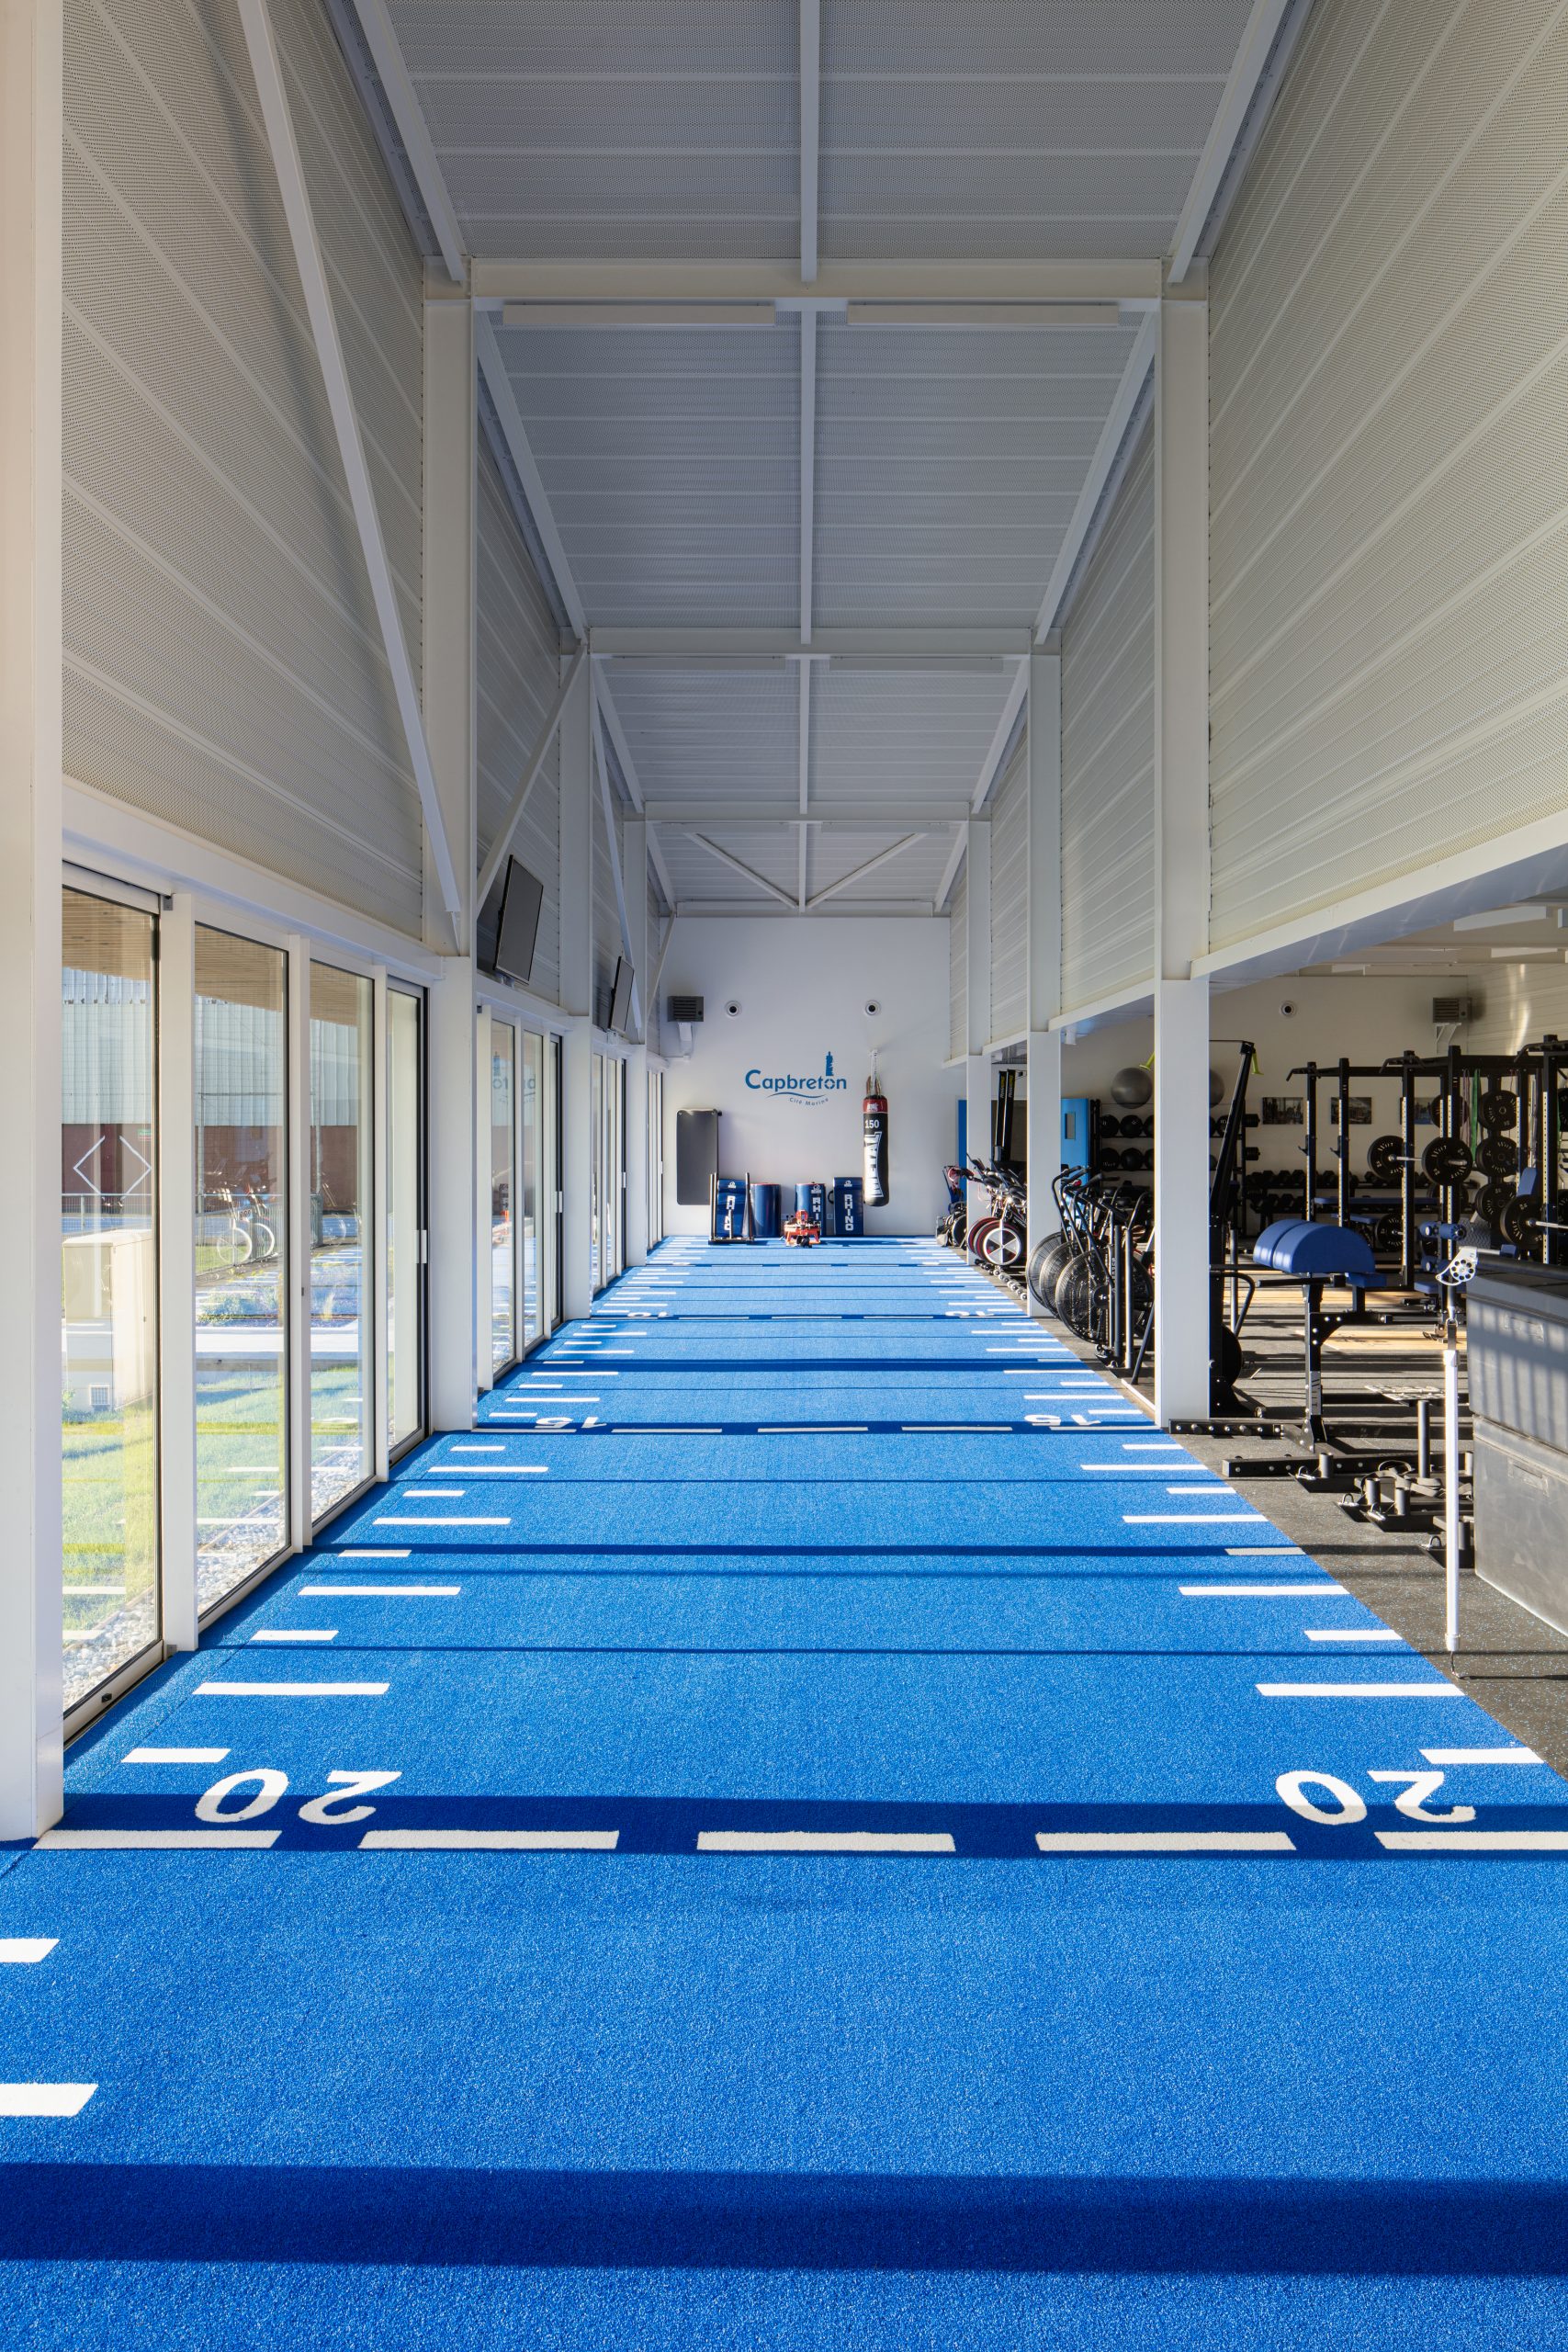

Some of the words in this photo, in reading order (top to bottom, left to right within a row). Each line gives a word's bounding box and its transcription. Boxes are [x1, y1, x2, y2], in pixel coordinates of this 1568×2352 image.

[745, 1069, 847, 1091] Capbreton
[865, 1120, 879, 1129] 150
[724, 1195, 736, 1231] RHNO
[845, 1194, 853, 1231] RHINO
[535, 1417, 607, 1429] 15
[1024, 1415, 1101, 1426] 15
[196, 1769, 403, 1825] 20
[1276, 1770, 1476, 1825] 20
